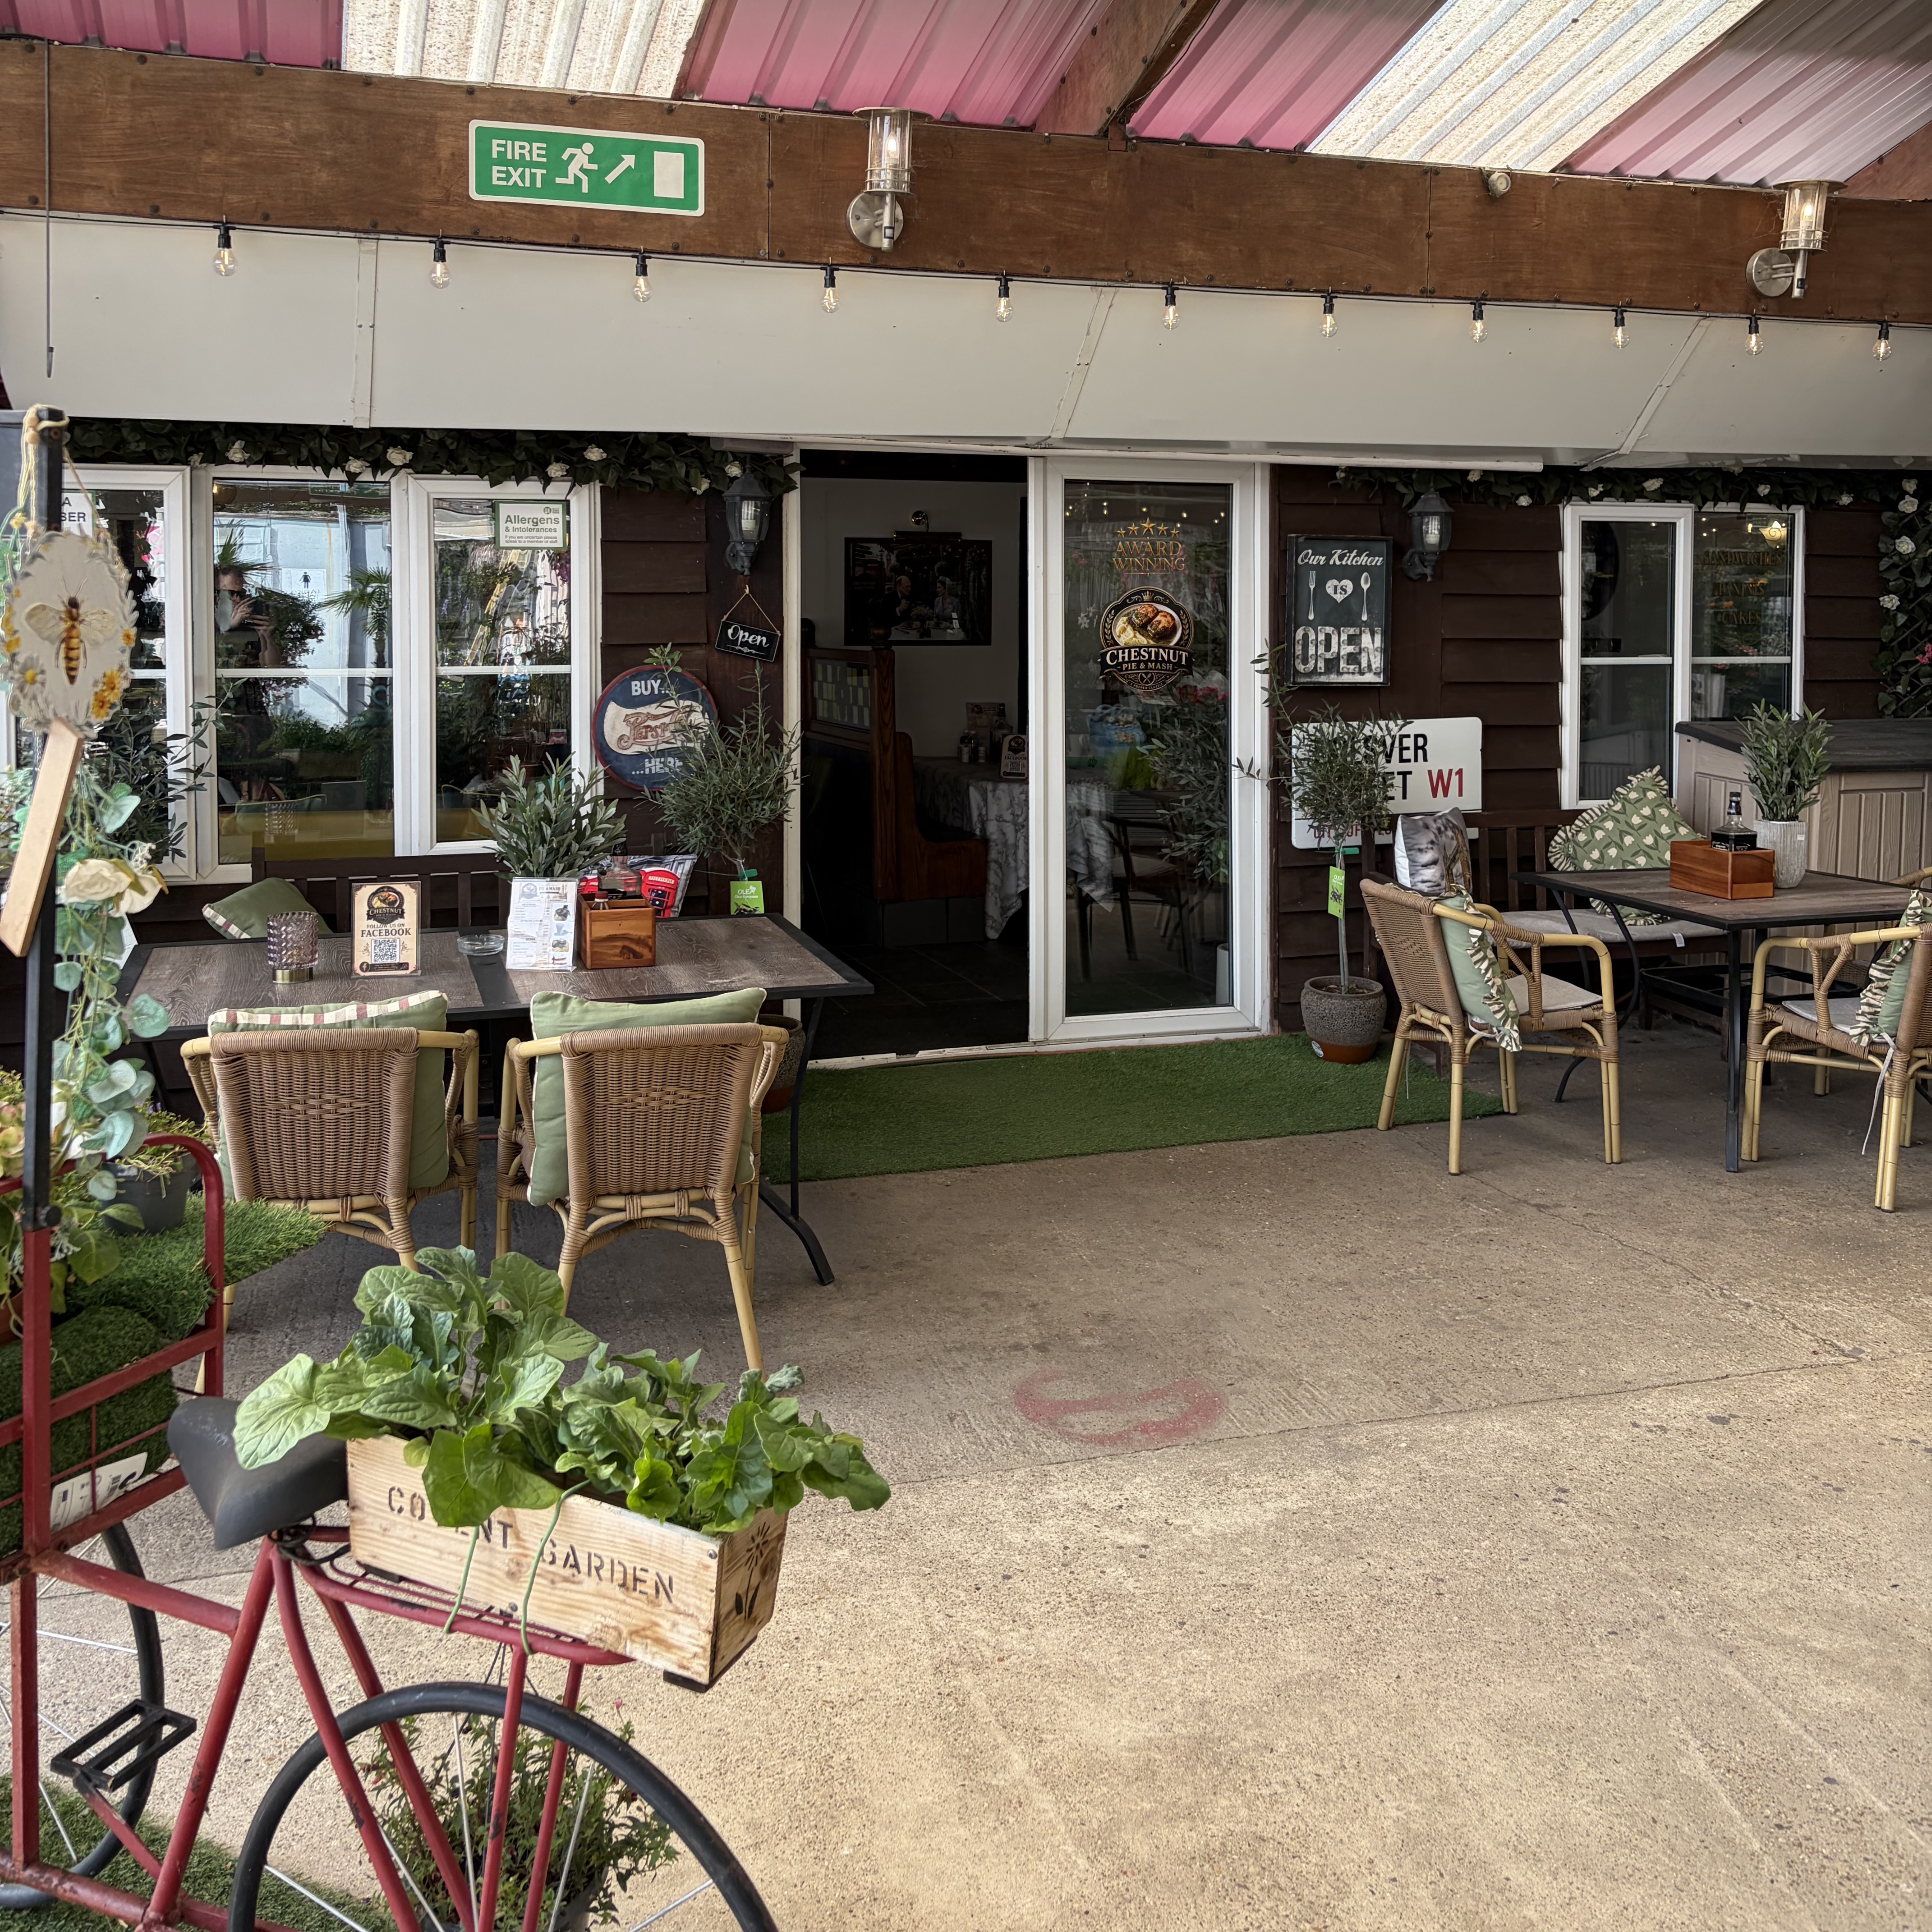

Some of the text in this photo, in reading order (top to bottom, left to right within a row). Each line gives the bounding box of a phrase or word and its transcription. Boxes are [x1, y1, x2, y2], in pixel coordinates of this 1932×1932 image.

[492, 139, 547, 162] FIRE
[492, 166, 547, 188] EXIT
[505, 515, 560, 526] Allergens
[1115, 541, 1182, 556] AWARD
[1112, 557, 1186, 571] WINNING
[1297, 549, 1384, 566] Our Kitchen
[1703, 551, 1782, 565] SANDWICHES
[1333, 585, 1348, 595] IS
[1722, 611, 1762, 624] CAKES
[727, 625, 769, 647] Open
[1106, 648, 1188, 665] CHESTNUT
[1295, 626, 1382, 673] OPEN
[1427, 768, 1463, 798] W1
[361, 928, 411, 937] FACEBOOK
[388, 1486, 673, 1603] CONT GARDEN
